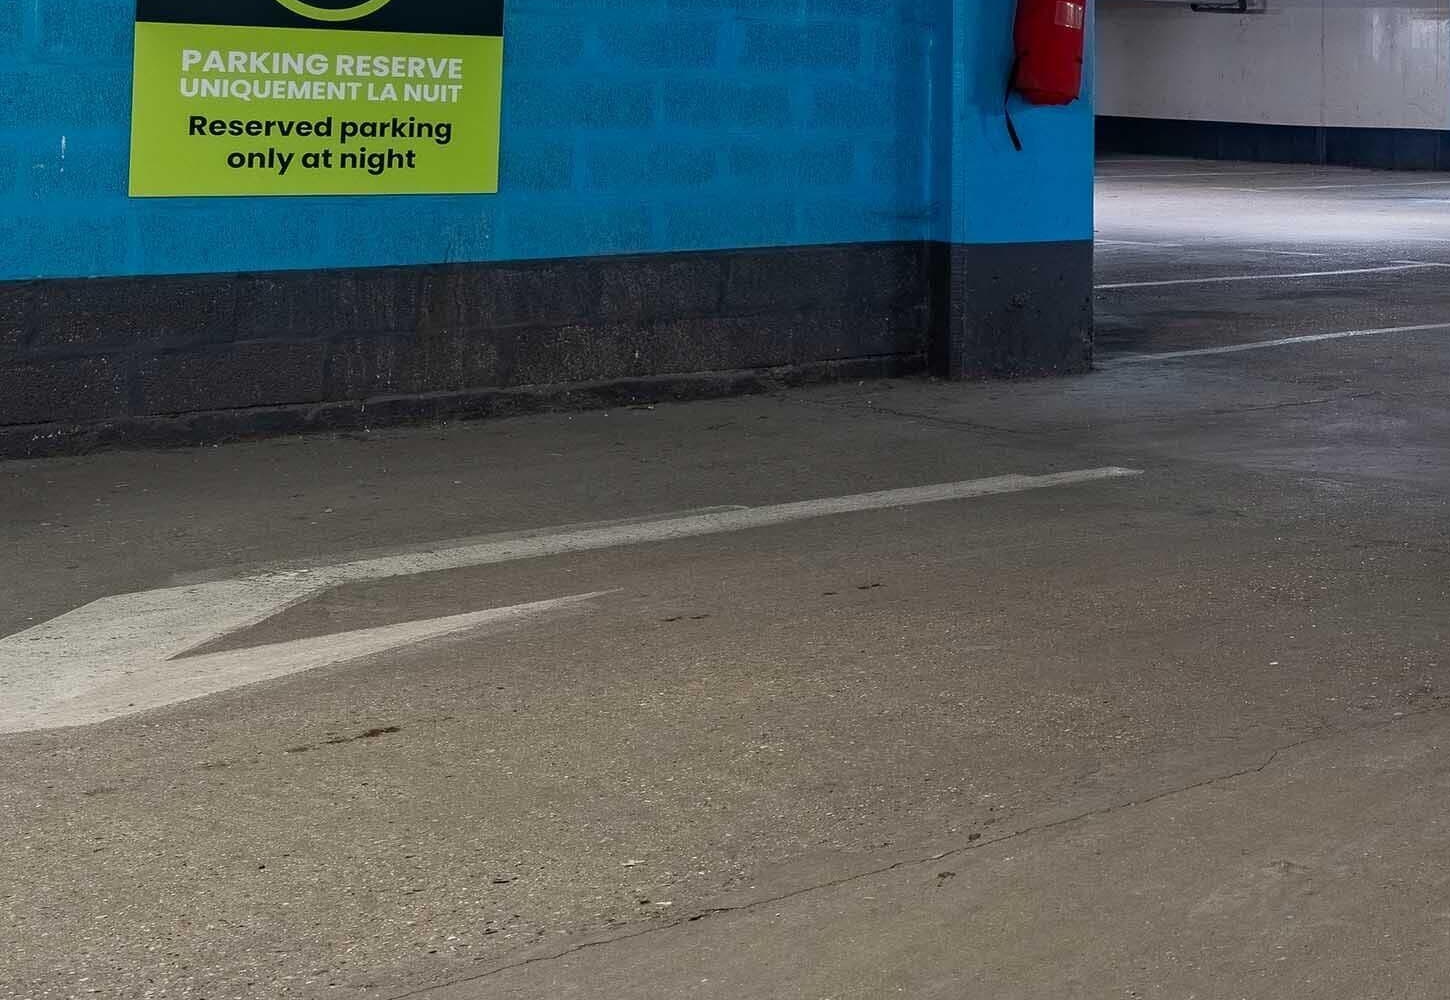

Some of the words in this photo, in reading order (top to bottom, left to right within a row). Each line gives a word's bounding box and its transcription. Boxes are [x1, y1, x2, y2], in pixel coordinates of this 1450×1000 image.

[181, 49, 328, 76] PARKING
[336, 53, 463, 80] RESERVE
[180, 76, 359, 102] UNIQUEMENT
[367, 81, 398, 103] LA
[403, 83, 463, 104] NUIT
[188, 114, 332, 138] Reserved
[340, 116, 453, 145] parking
[226, 148, 294, 175] only
[302, 148, 333, 170] at
[339, 147, 416, 176] night
